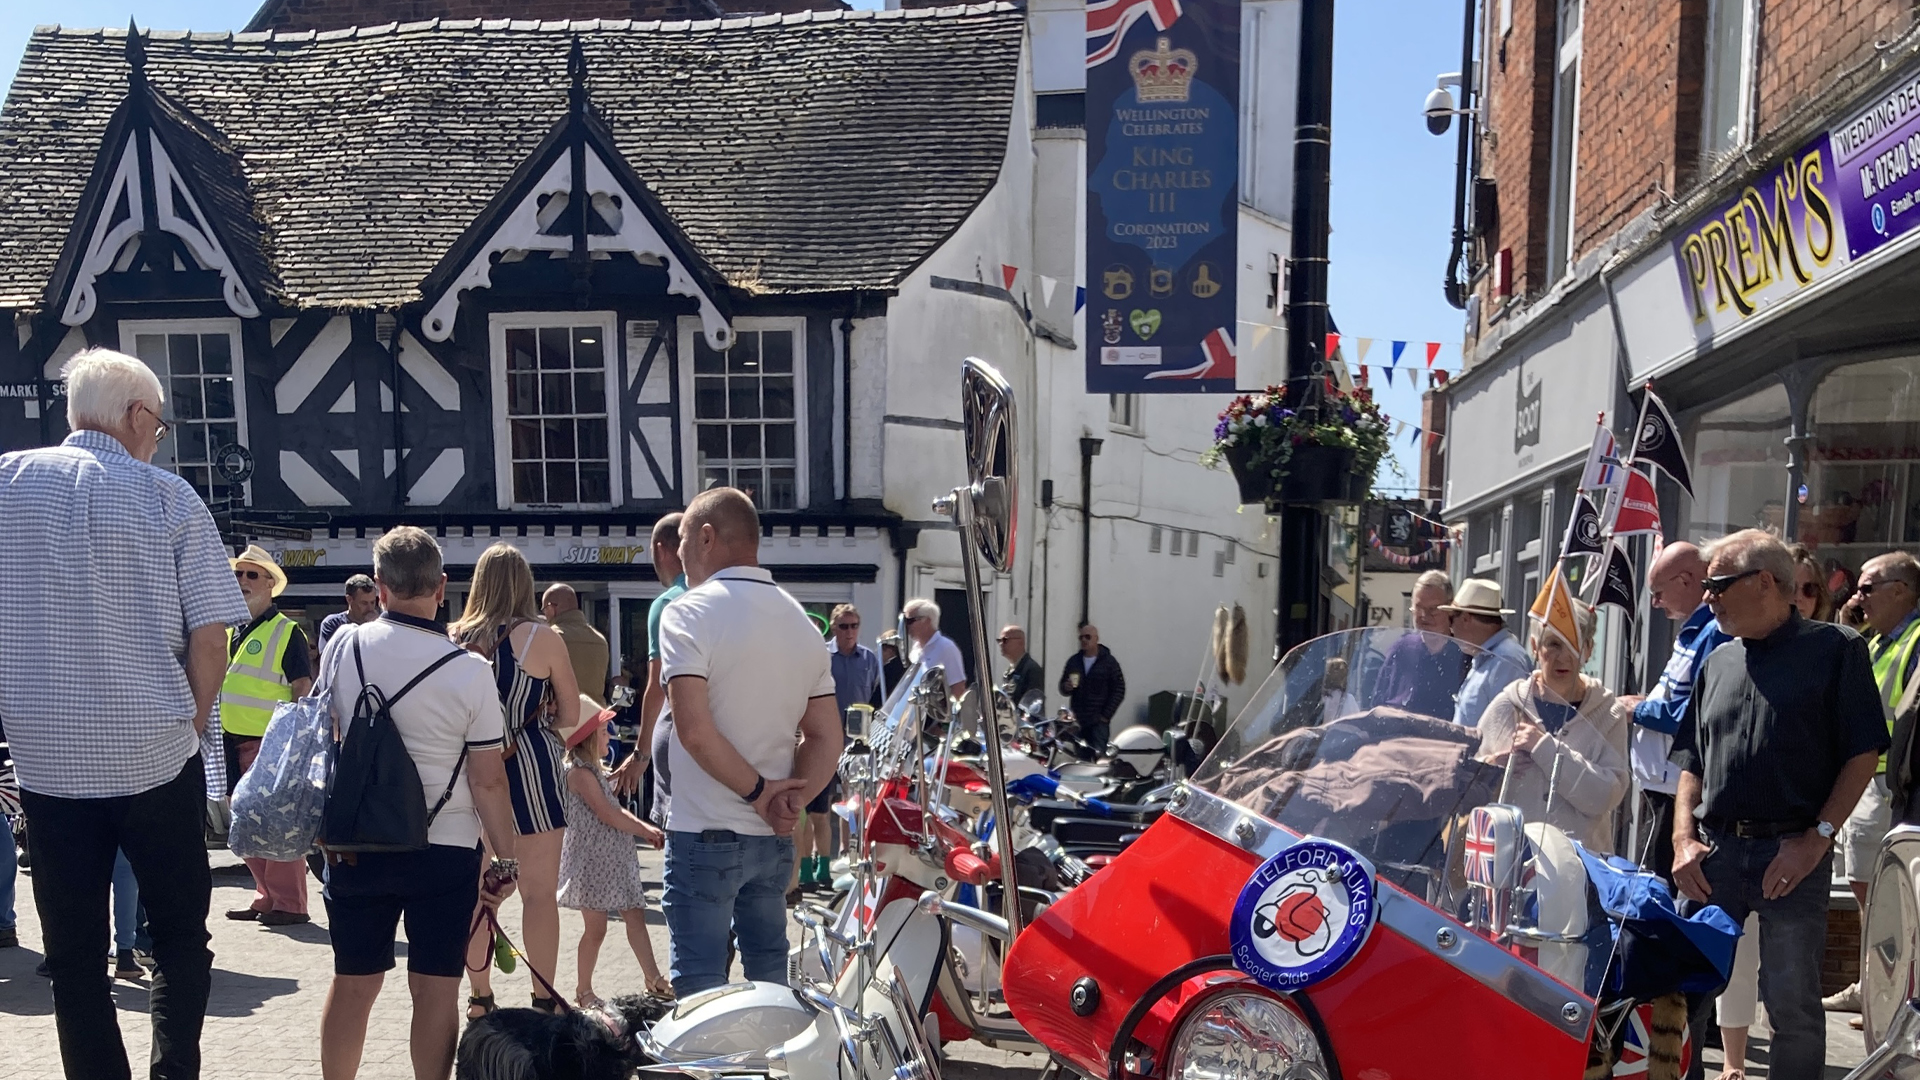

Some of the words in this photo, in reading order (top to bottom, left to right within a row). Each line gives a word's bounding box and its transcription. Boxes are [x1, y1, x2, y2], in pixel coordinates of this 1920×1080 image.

[1116, 107, 1210, 122] WELLINGTON
[1121, 122, 1204, 137] CELEBRATES
[1838, 100, 1896, 156] WEDDING
[1131, 146, 1194, 167] KING
[1875, 141, 1909, 191] 07540
[1112, 169, 1213, 191] CHARLES
[1148, 192, 1176, 213] III
[1113, 222, 1210, 236] CORONATION
[1680, 149, 1836, 325] PREM'S
[1145, 236, 1178, 249] 2023
[0, 384, 39, 397] MARKE
[270, 548, 327, 566] BWAY
[563, 545, 645, 564] SUBWAY
[1370, 606, 1393, 626] EN
[1250, 849, 1338, 888] TELFORD
[1341, 861, 1367, 926] DUKES
[1237, 944, 1276, 983] Scooter
[1278, 971, 1309, 985] Club
